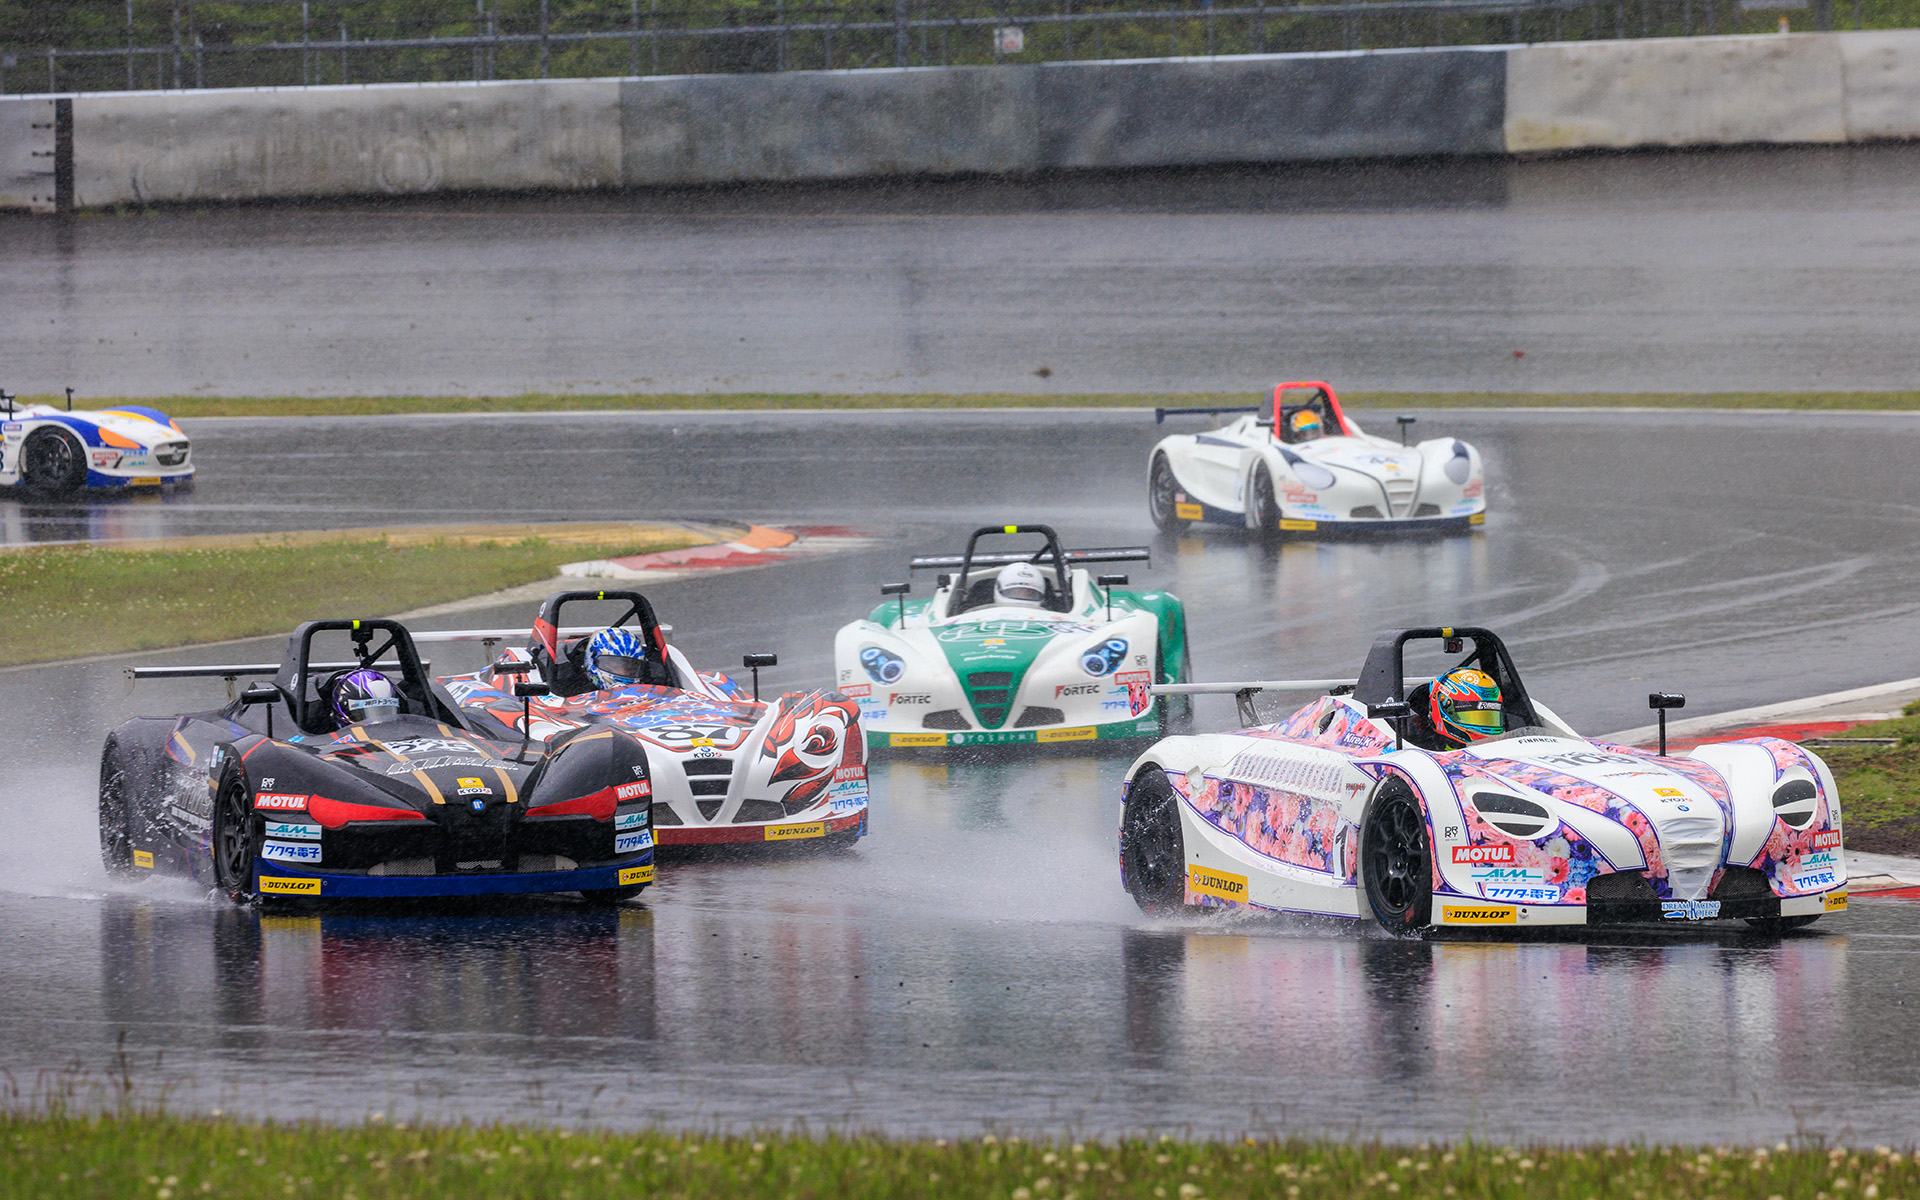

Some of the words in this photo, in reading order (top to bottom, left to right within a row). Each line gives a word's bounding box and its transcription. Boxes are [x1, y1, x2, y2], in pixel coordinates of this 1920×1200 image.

[1055, 685, 1100, 699] FORTEC
[889, 693, 932, 706] FORTEC
[649, 725, 730, 740] 87
[1050, 730, 1092, 738] DUNLOP
[836, 767, 864, 780] MOTUL
[617, 782, 650, 799] MOTUL
[257, 796, 304, 808] MOTUL
[777, 826, 820, 836] DUNLOP
[1815, 832, 1840, 847] MOTUL
[265, 845, 320, 858] フクダ電子
[1455, 847, 1511, 861] MOTUL
[268, 881, 315, 890] DUNLOP
[1202, 875, 1243, 893] DUNLOP
[1487, 888, 1558, 899] フクダ電子
[1662, 902, 1690, 910] DREAM
